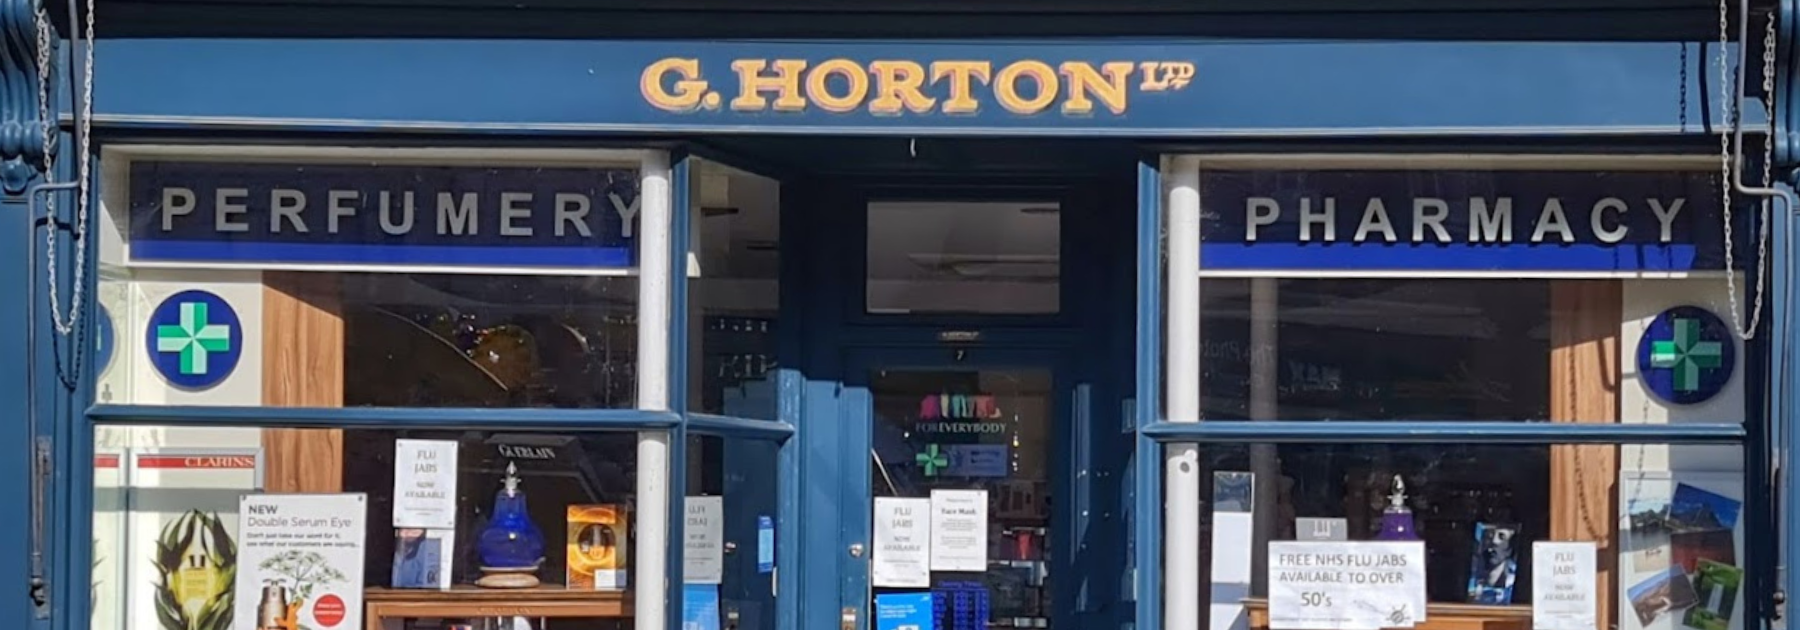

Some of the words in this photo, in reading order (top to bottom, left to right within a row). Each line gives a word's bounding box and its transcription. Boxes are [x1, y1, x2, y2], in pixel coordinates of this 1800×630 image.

[640, 57, 720, 112] G.
[731, 59, 1135, 117] HORTON
[1139, 61, 1196, 92] LTD
[160, 187, 640, 238] PERFUMERY
[1245, 197, 1686, 243] PHARMACY
[417, 450, 437, 460] FLU
[184, 456, 255, 467] CLARINS
[414, 463, 438, 474] JABS
[248, 504, 278, 515] NEW
[894, 507, 912, 516] FLU
[247, 517, 288, 528] Double
[291, 517, 328, 528] Serum
[330, 517, 352, 529] Eye
[892, 519, 913, 529] JABS
[1279, 554, 1311, 566] FREE
[1315, 554, 1344, 566] NHS
[1347, 554, 1372, 567] FLU
[1375, 554, 1407, 567] JABS
[1555, 552, 1575, 562] FLU
[1552, 565, 1576, 577] JABS
[1279, 571, 1343, 583] AVAILABLE
[1349, 571, 1366, 584] TO
[1369, 572, 1405, 584] OVER
[1301, 591, 1332, 607] 50's
